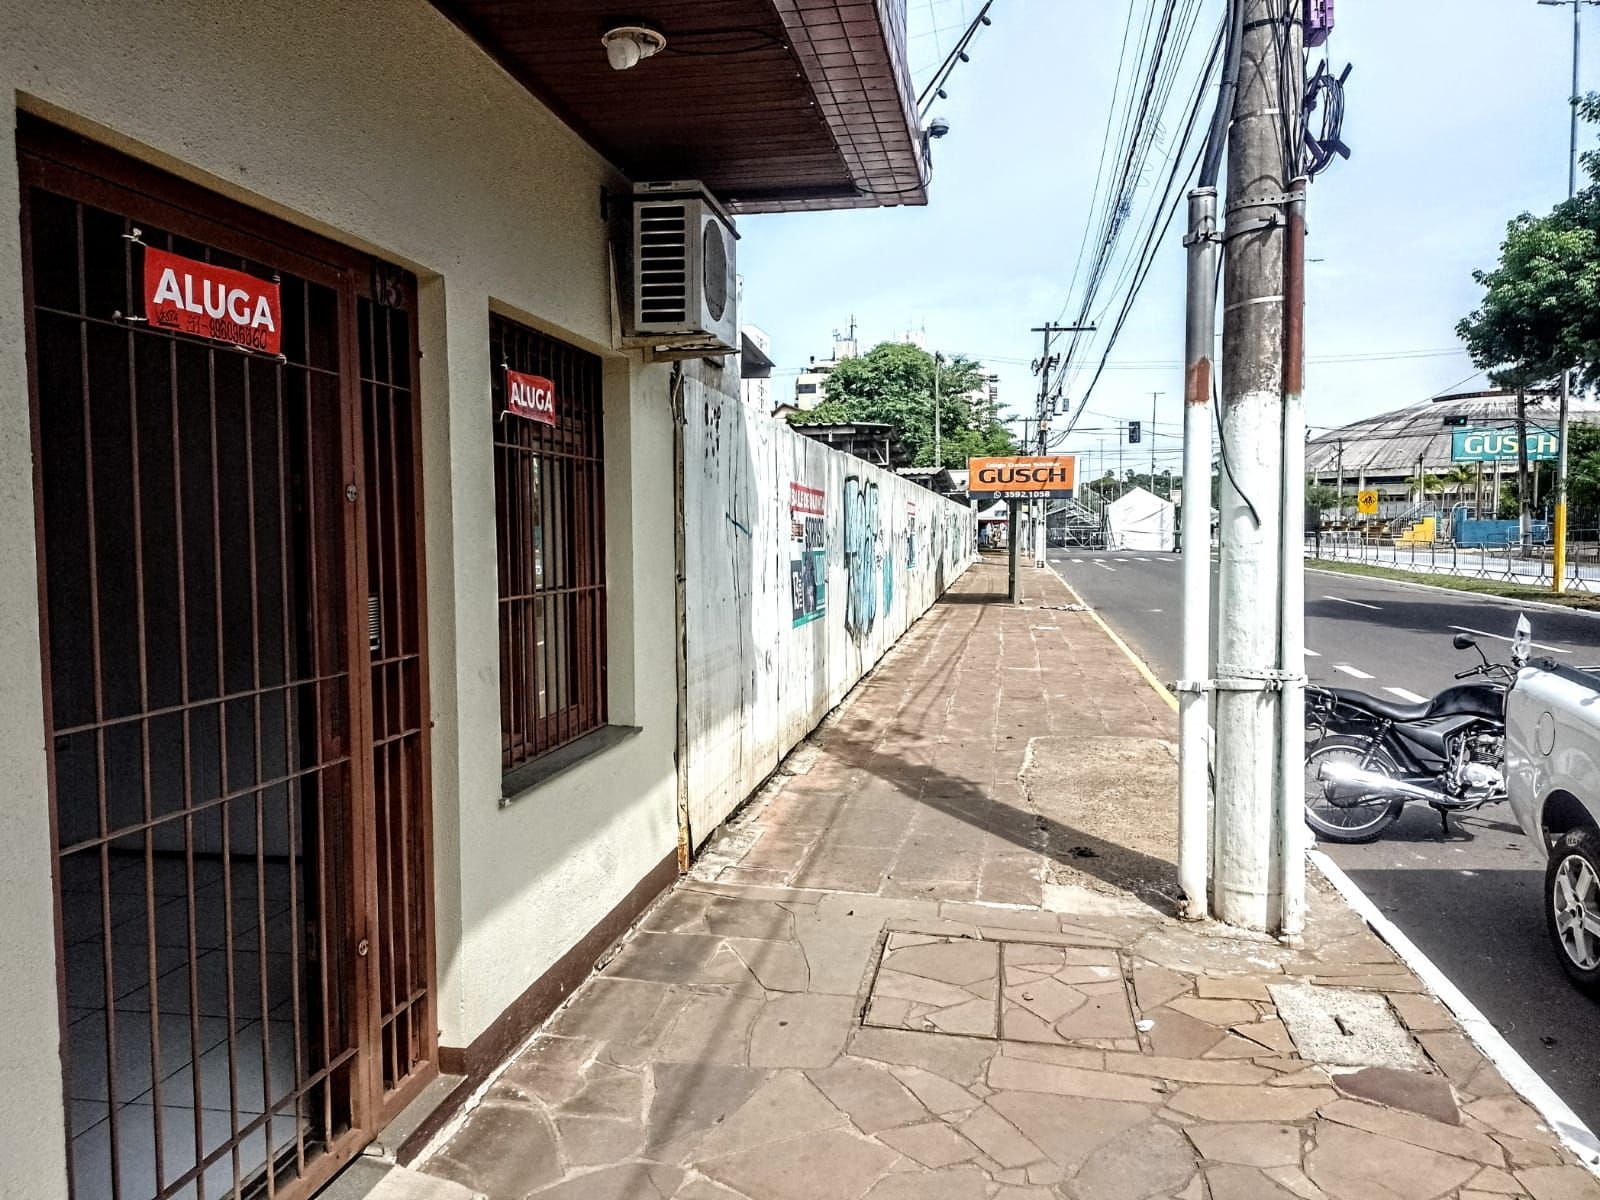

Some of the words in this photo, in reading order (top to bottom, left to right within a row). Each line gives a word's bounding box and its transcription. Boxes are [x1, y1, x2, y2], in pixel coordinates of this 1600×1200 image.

[153, 268, 275, 332] ALUGA
[510, 382, 553, 413] ALUGA
[978, 468, 1066, 484] GUSCH
